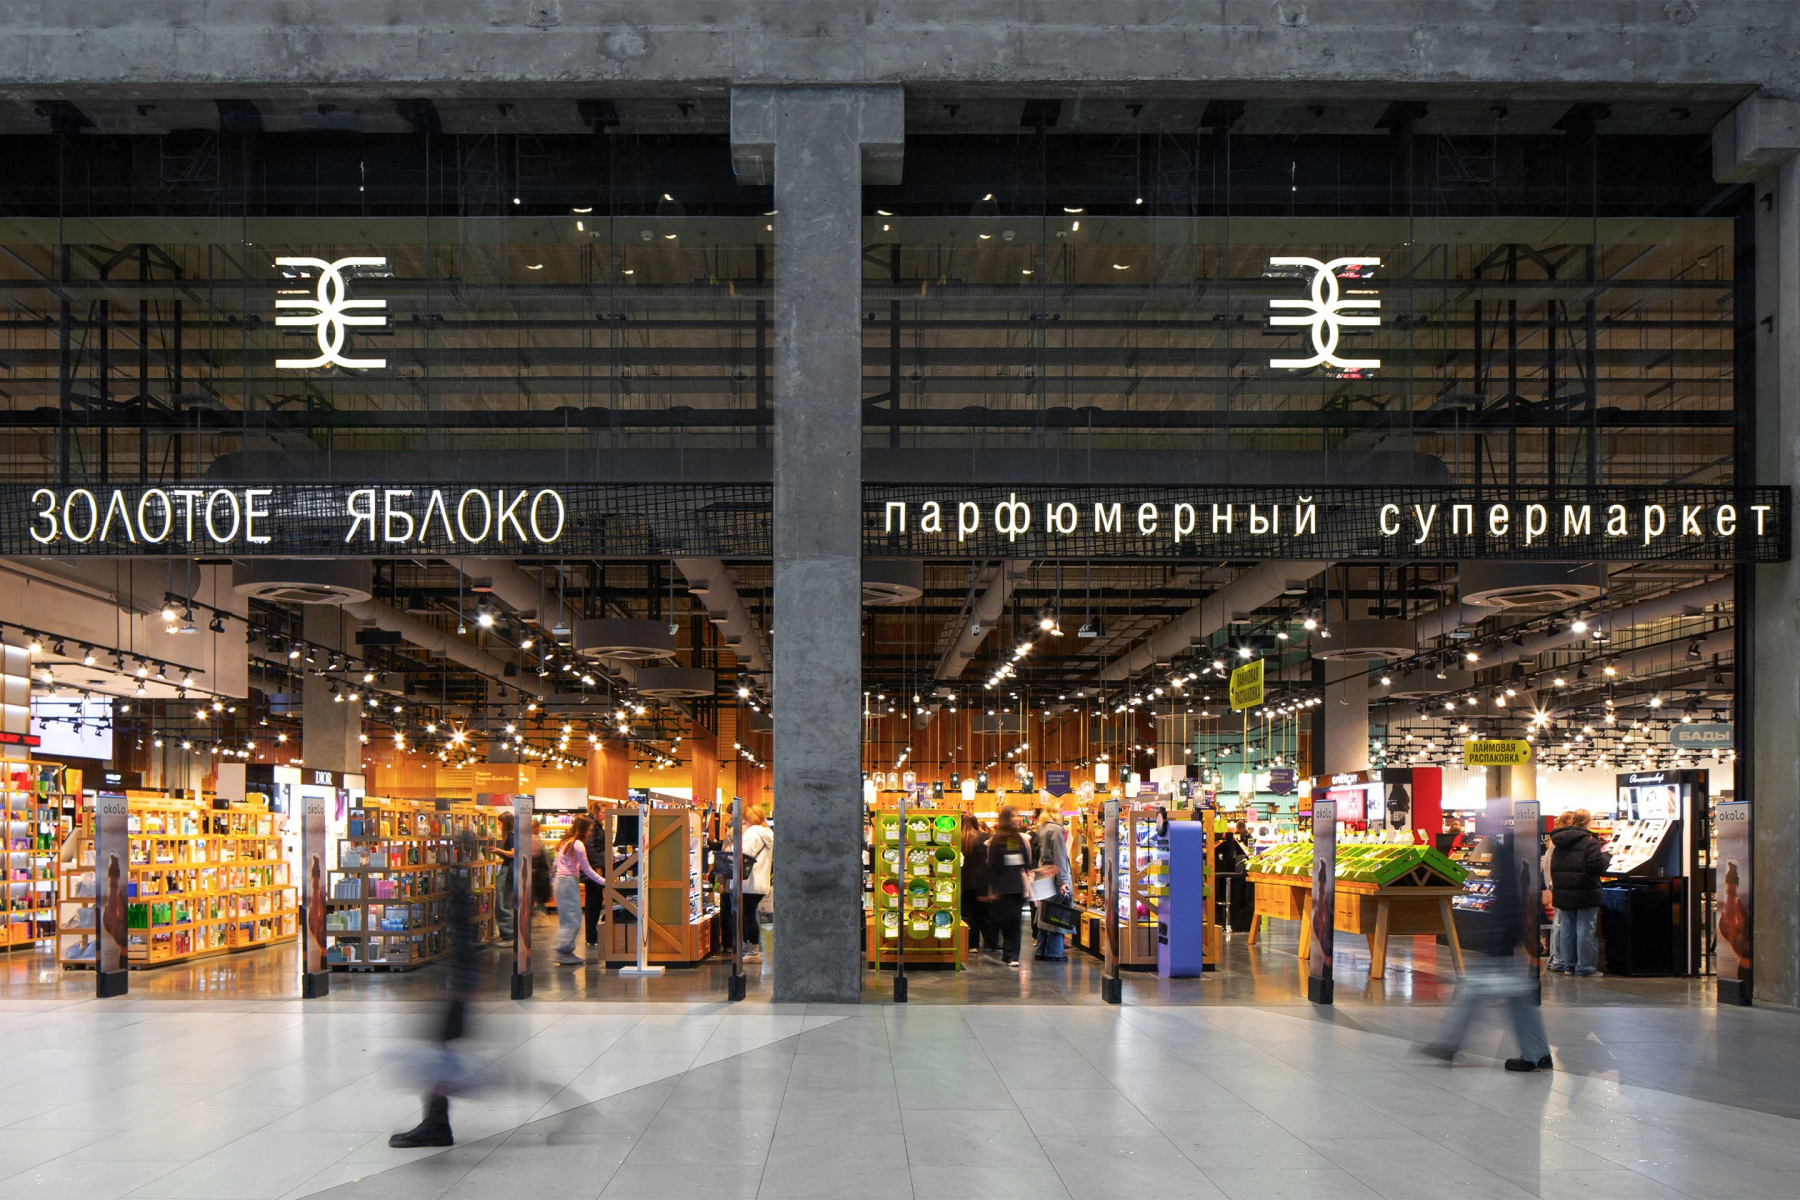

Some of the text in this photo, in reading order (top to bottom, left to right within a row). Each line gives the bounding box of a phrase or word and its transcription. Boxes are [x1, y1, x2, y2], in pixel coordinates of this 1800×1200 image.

[30, 489, 565, 543] ЗОЛОТОЕ ЯБЛОКО
[885, 492, 1771, 544] парфюмерный супермаркет
[1679, 731, 1730, 742] БАДЫ
[1472, 742, 1516, 753] ЛАЙМОВАЯ
[1469, 753, 1520, 763] РАСПАКОВКА
[315, 771, 332, 785] DIOR
[103, 804, 126, 814] okolo
[307, 803, 324, 815] okolo
[1315, 808, 1332, 818] okolo
[1516, 809, 1535, 820] okolo
[1720, 810, 1746, 821] okolo
